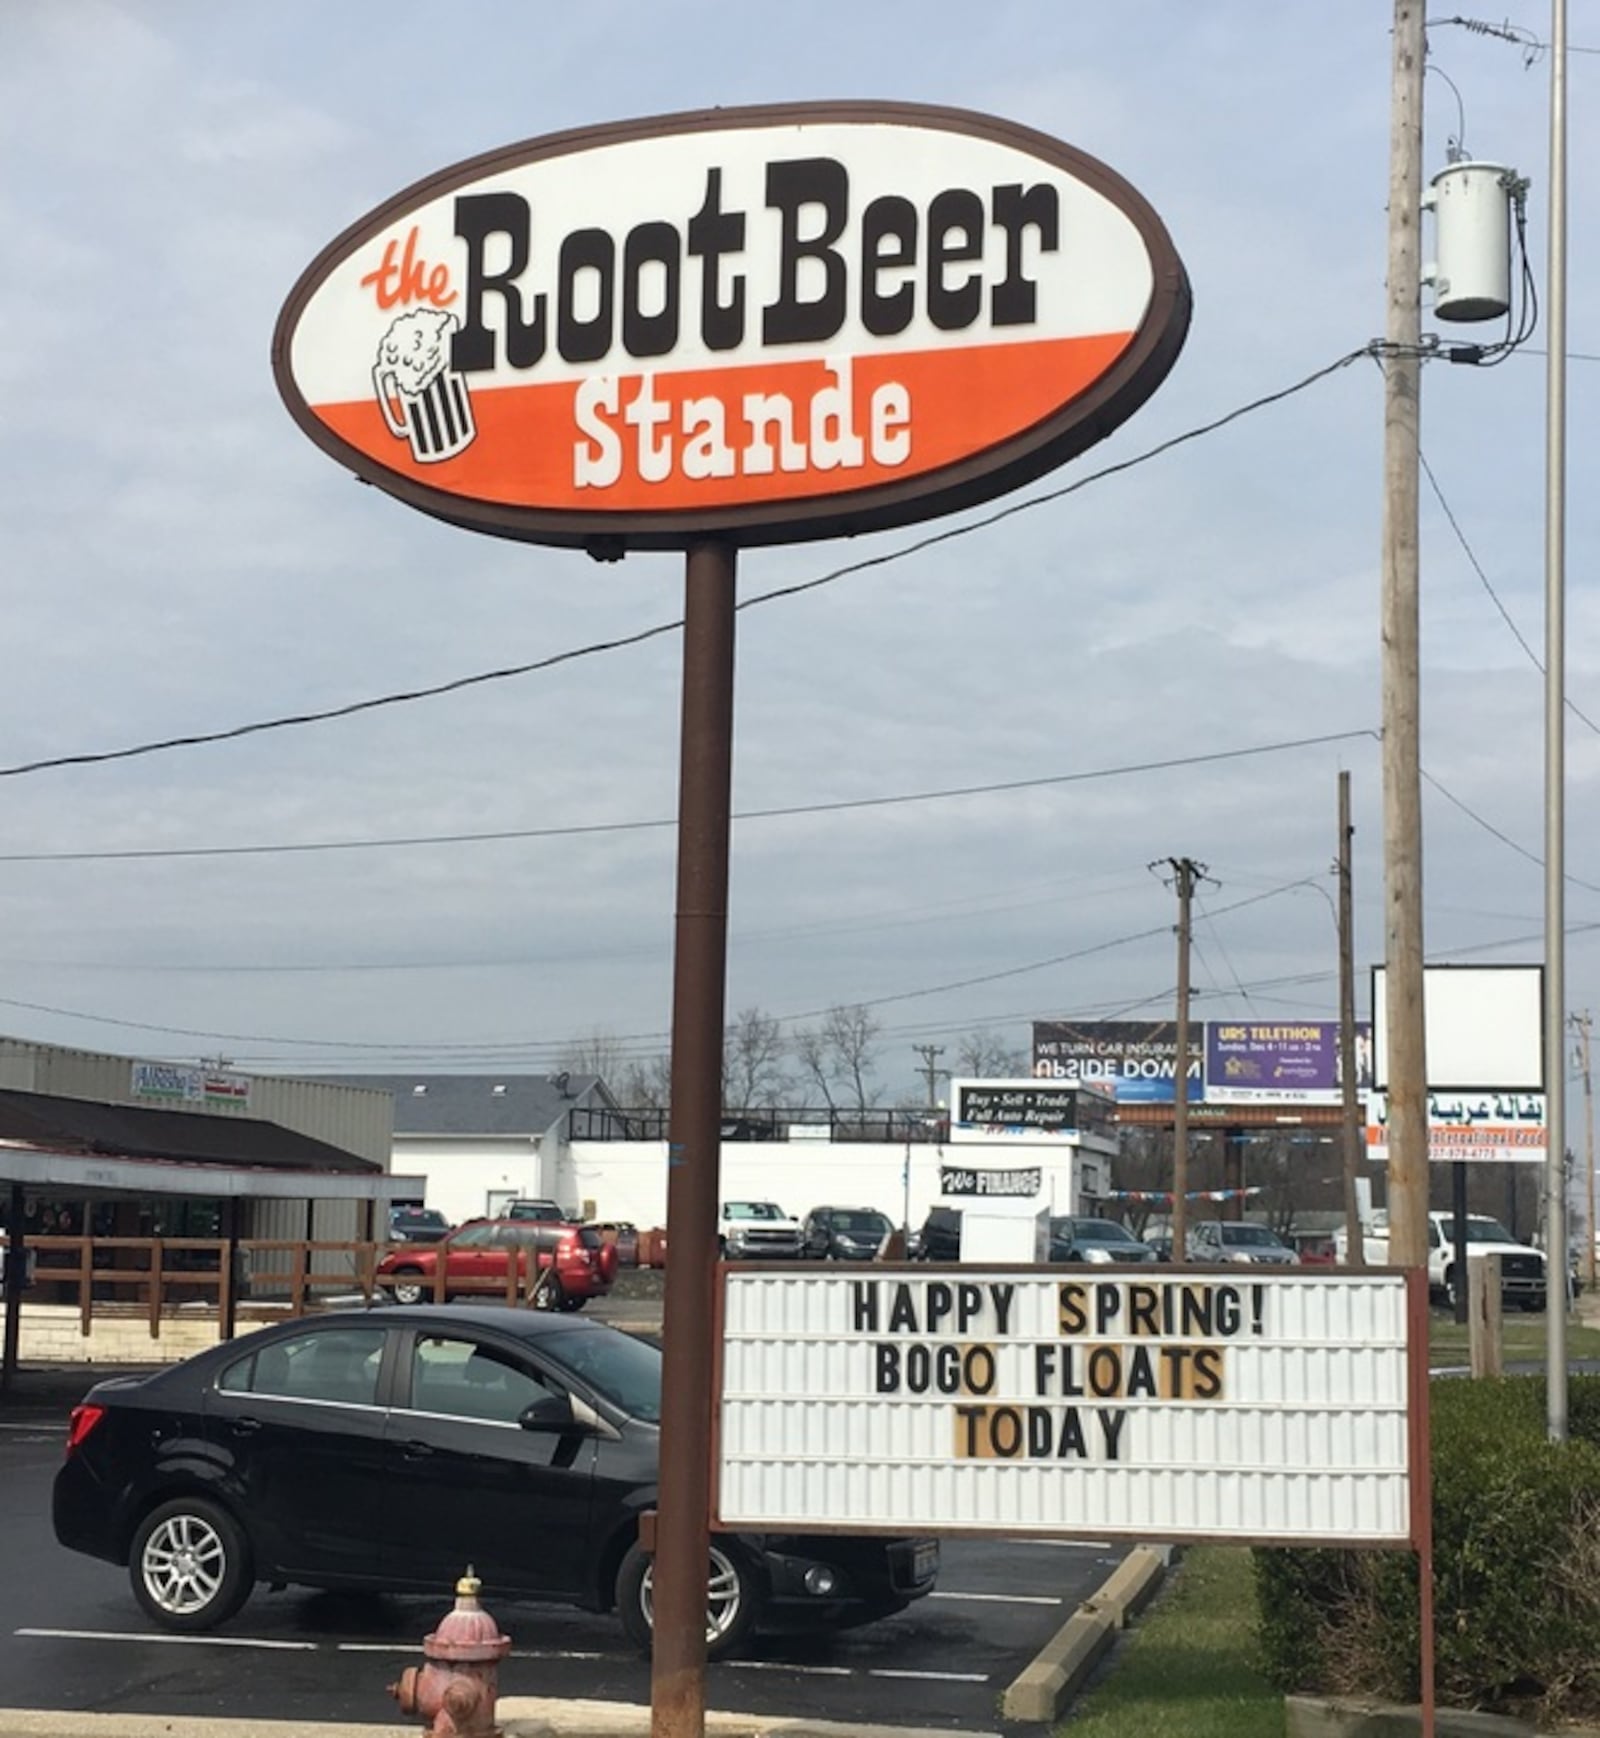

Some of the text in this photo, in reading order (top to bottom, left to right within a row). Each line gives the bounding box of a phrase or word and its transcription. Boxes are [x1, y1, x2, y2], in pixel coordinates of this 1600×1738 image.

[361, 228, 457, 310] the
[450, 156, 1060, 372] Root Beer
[573, 357, 912, 490] Stande
[1036, 1042, 1058, 1055] WE
[1059, 1042, 1095, 1056] TURN
[1097, 1042, 1123, 1056] CAR
[1250, 1027, 1321, 1041] TELETHON
[966, 1092, 1070, 1108] Buy Sell Trade
[966, 1109, 1066, 1126] Full Auto Repair
[977, 1170, 1041, 1195] FINANCE
[853, 1282, 1263, 1335] HAPPY SPRING!
[876, 1344, 1222, 1398] BOGO FLOATS
[957, 1406, 1127, 1459] TODAY
